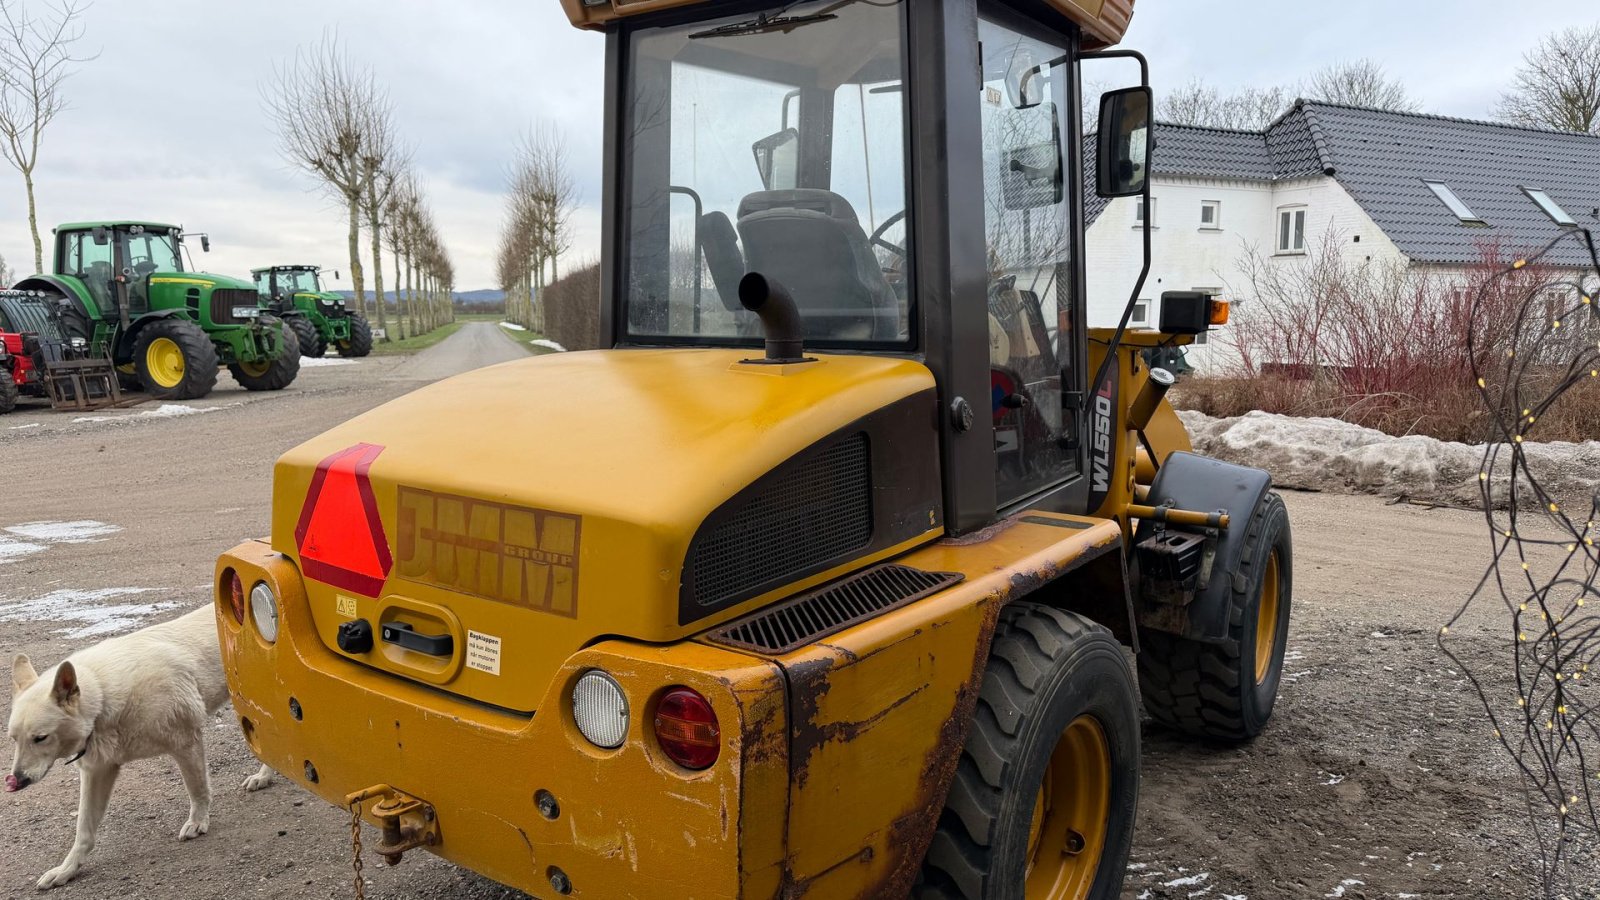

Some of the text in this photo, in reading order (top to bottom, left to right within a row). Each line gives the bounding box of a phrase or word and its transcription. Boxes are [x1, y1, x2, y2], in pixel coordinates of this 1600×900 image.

[1093, 380, 1112, 492] WL550L
[504, 545, 572, 567] GROUP
[469, 632, 498, 644] Bagklappen
